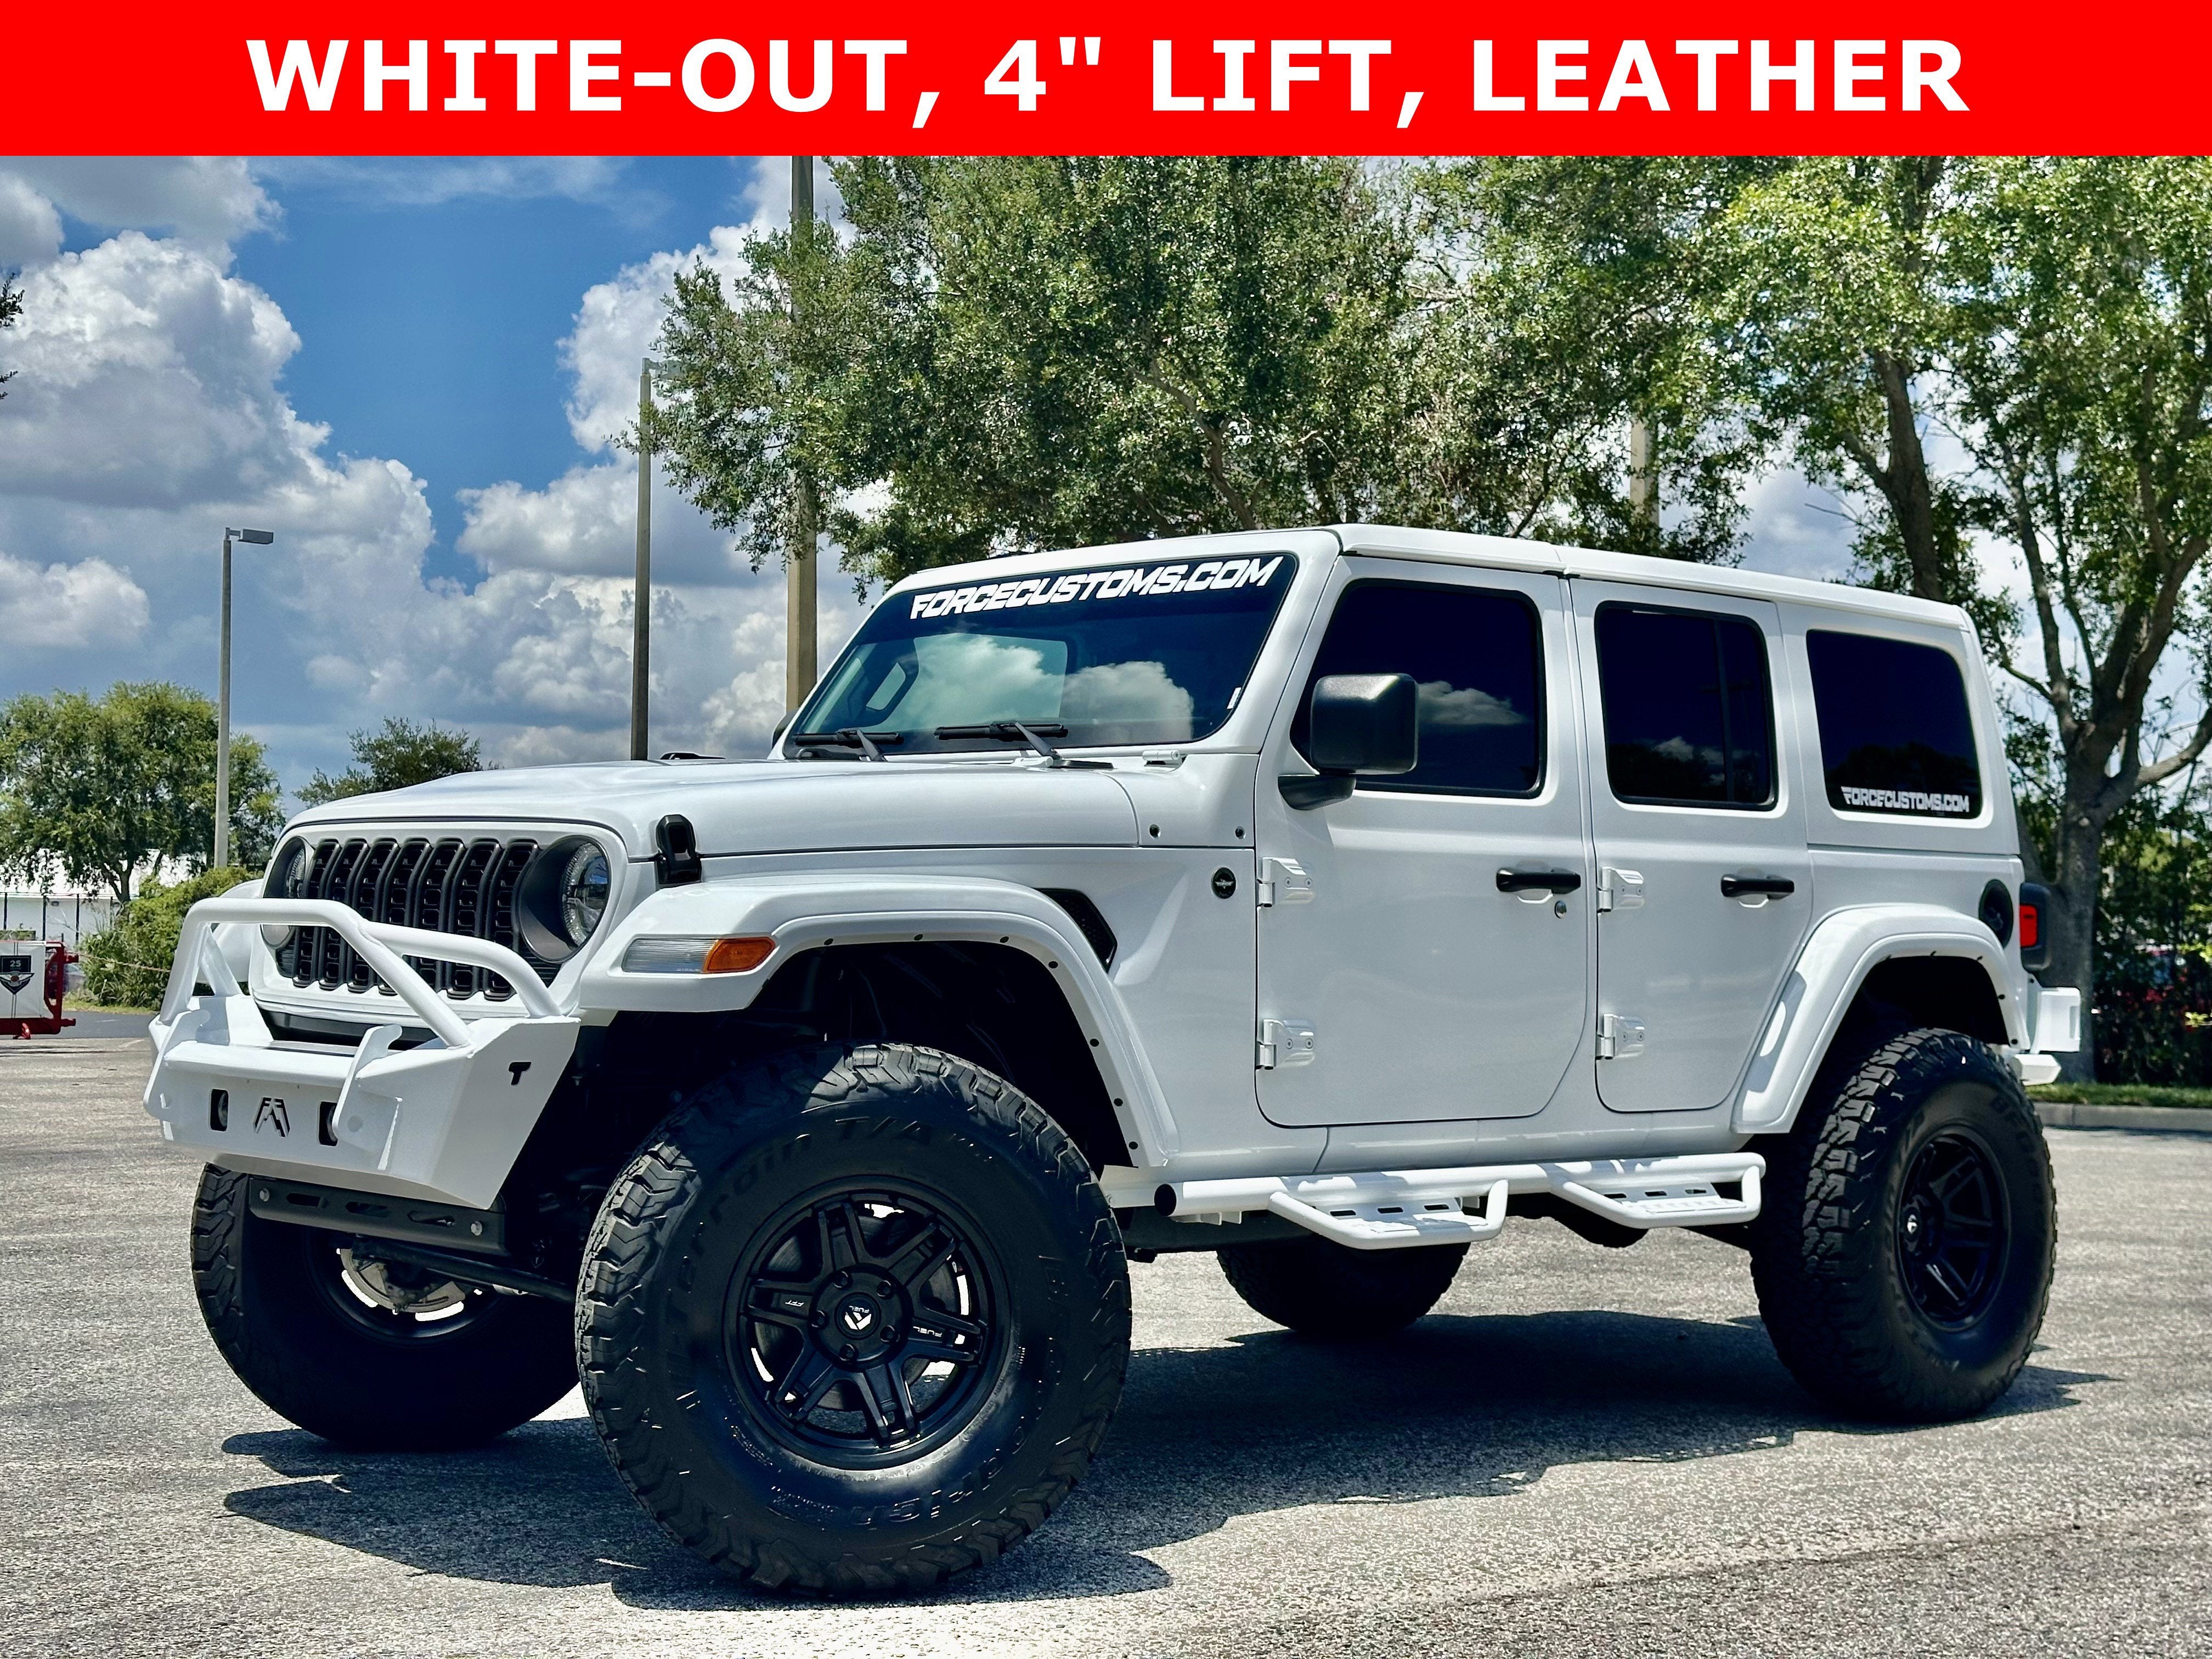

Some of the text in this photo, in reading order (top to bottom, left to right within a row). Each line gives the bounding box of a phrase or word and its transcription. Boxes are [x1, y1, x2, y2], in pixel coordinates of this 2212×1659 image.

[910, 556, 1283, 619] FORCECUSTOMS.COM
[1841, 786, 1969, 812] FORCECUSTOMS.COM
[849, 1305, 870, 1313] FUEL
[913, 1325, 943, 1338] FUEL
